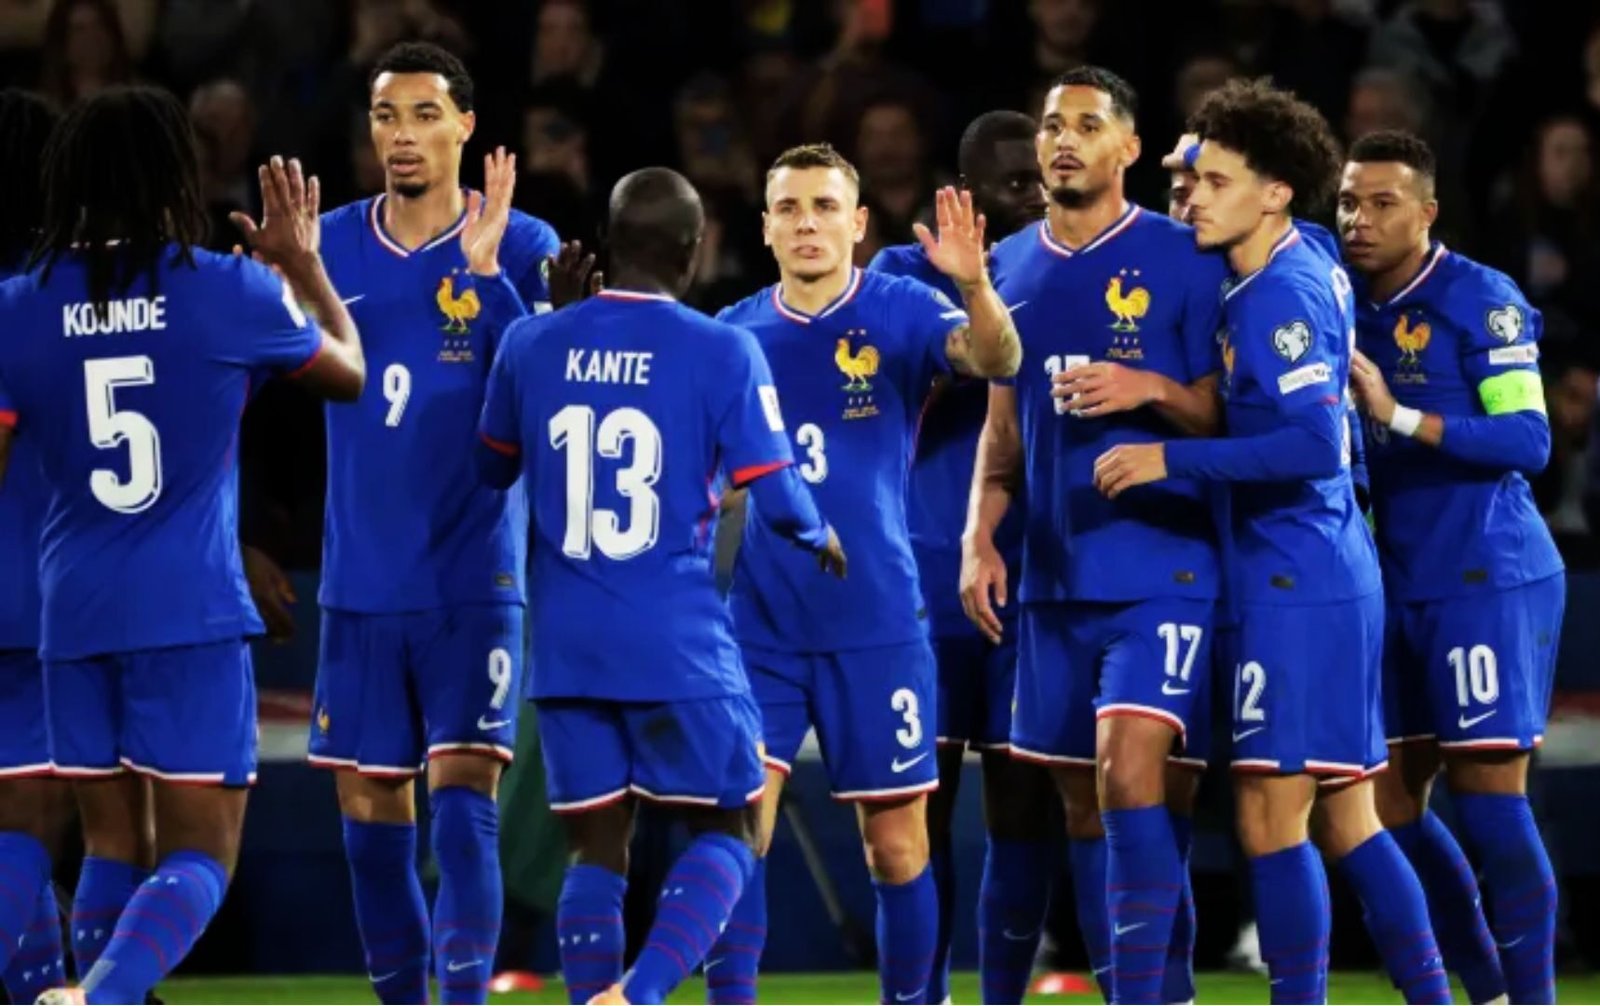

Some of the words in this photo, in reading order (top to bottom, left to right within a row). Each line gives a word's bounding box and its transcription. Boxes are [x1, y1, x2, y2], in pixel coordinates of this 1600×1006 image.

[63, 296, 167, 337] KOUNDE
[383, 363, 411, 427] 9
[565, 348, 653, 385] KANTE
[84, 355, 163, 514] 5
[796, 422, 828, 484] 3
[548, 404, 662, 561] 13
[488, 647, 512, 709] 9
[1157, 622, 1203, 681] 17
[1446, 644, 1499, 706] 10
[891, 687, 923, 748] 3
